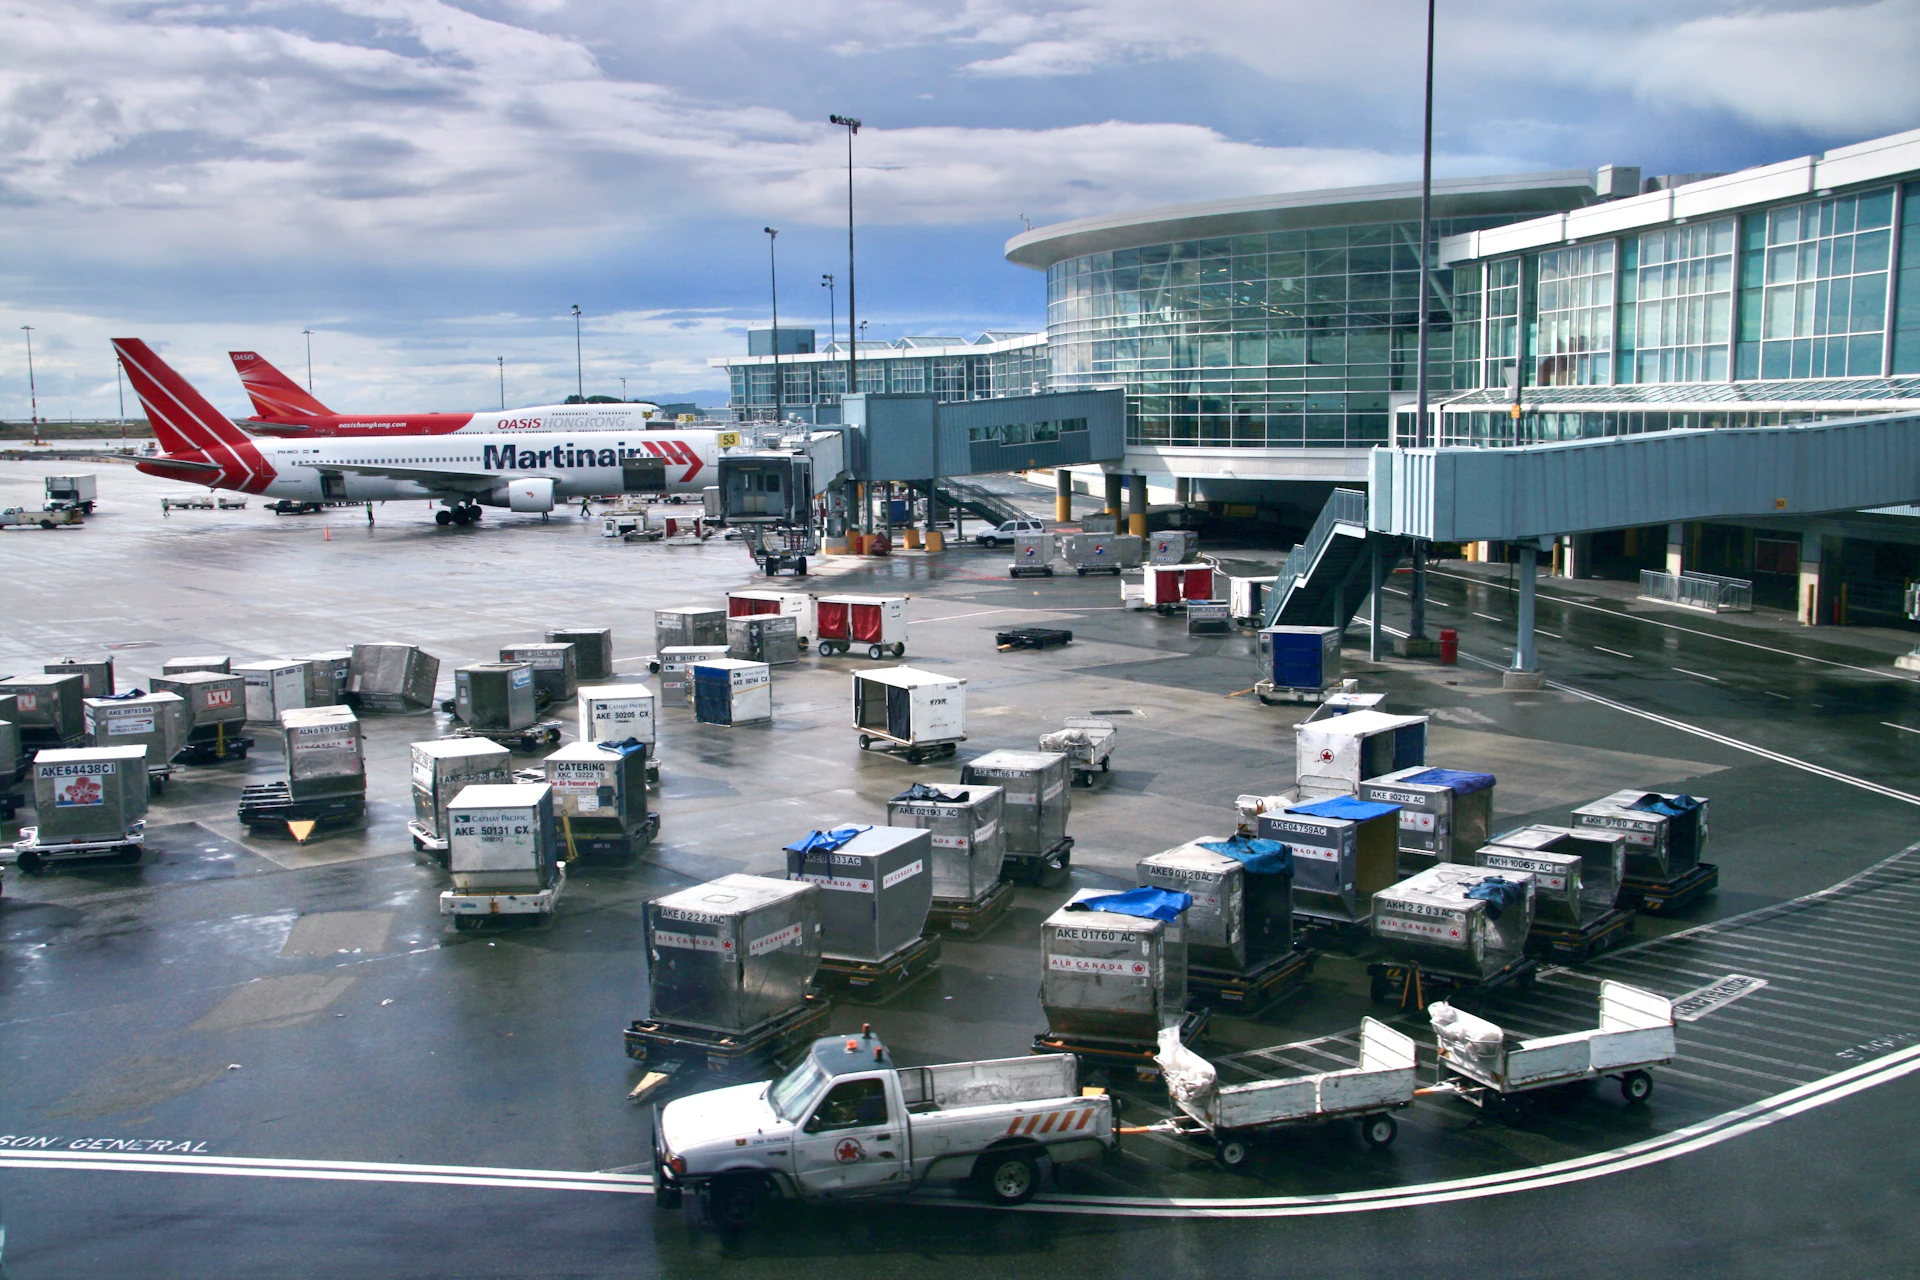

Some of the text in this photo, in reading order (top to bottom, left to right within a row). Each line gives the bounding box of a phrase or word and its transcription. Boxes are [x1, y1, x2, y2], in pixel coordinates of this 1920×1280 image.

[338, 421, 407, 430] oasishongkong.com
[542, 417, 626, 430] HONGKONG
[723, 434, 736, 445] 53
[484, 441, 640, 470] Martinair
[207, 690, 232, 705] LTU
[108, 709, 123, 717] AKE
[615, 711, 636, 719] 50205
[639, 710, 650, 718] CX
[558, 763, 606, 771] CATERING
[974, 769, 991, 777] AKE
[445, 774, 461, 783] AKE
[495, 769, 508, 779] CX
[588, 780, 599, 788] only
[1371, 791, 1424, 803] AKE 90212 AC
[900, 807, 957, 817] AKE 02193 AC
[471, 814, 528, 823] CATHAY PACIFIC
[1585, 817, 1644, 830] AKH 9700 AC
[455, 825, 529, 836] AKE 50131 CX
[1488, 857, 1551, 872] AKH 10065 AC
[813, 878, 852, 888] CANADA
[1380, 919, 1443, 935] AIR CANADA
[657, 934, 716, 947] AIR CANADA
[751, 930, 791, 951] AIR CANADA
[1056, 929, 1136, 943] AKE 01760 AC
[1052, 959, 1123, 971] AIR CANADA
[68, 1138, 209, 1153] GENERAL
